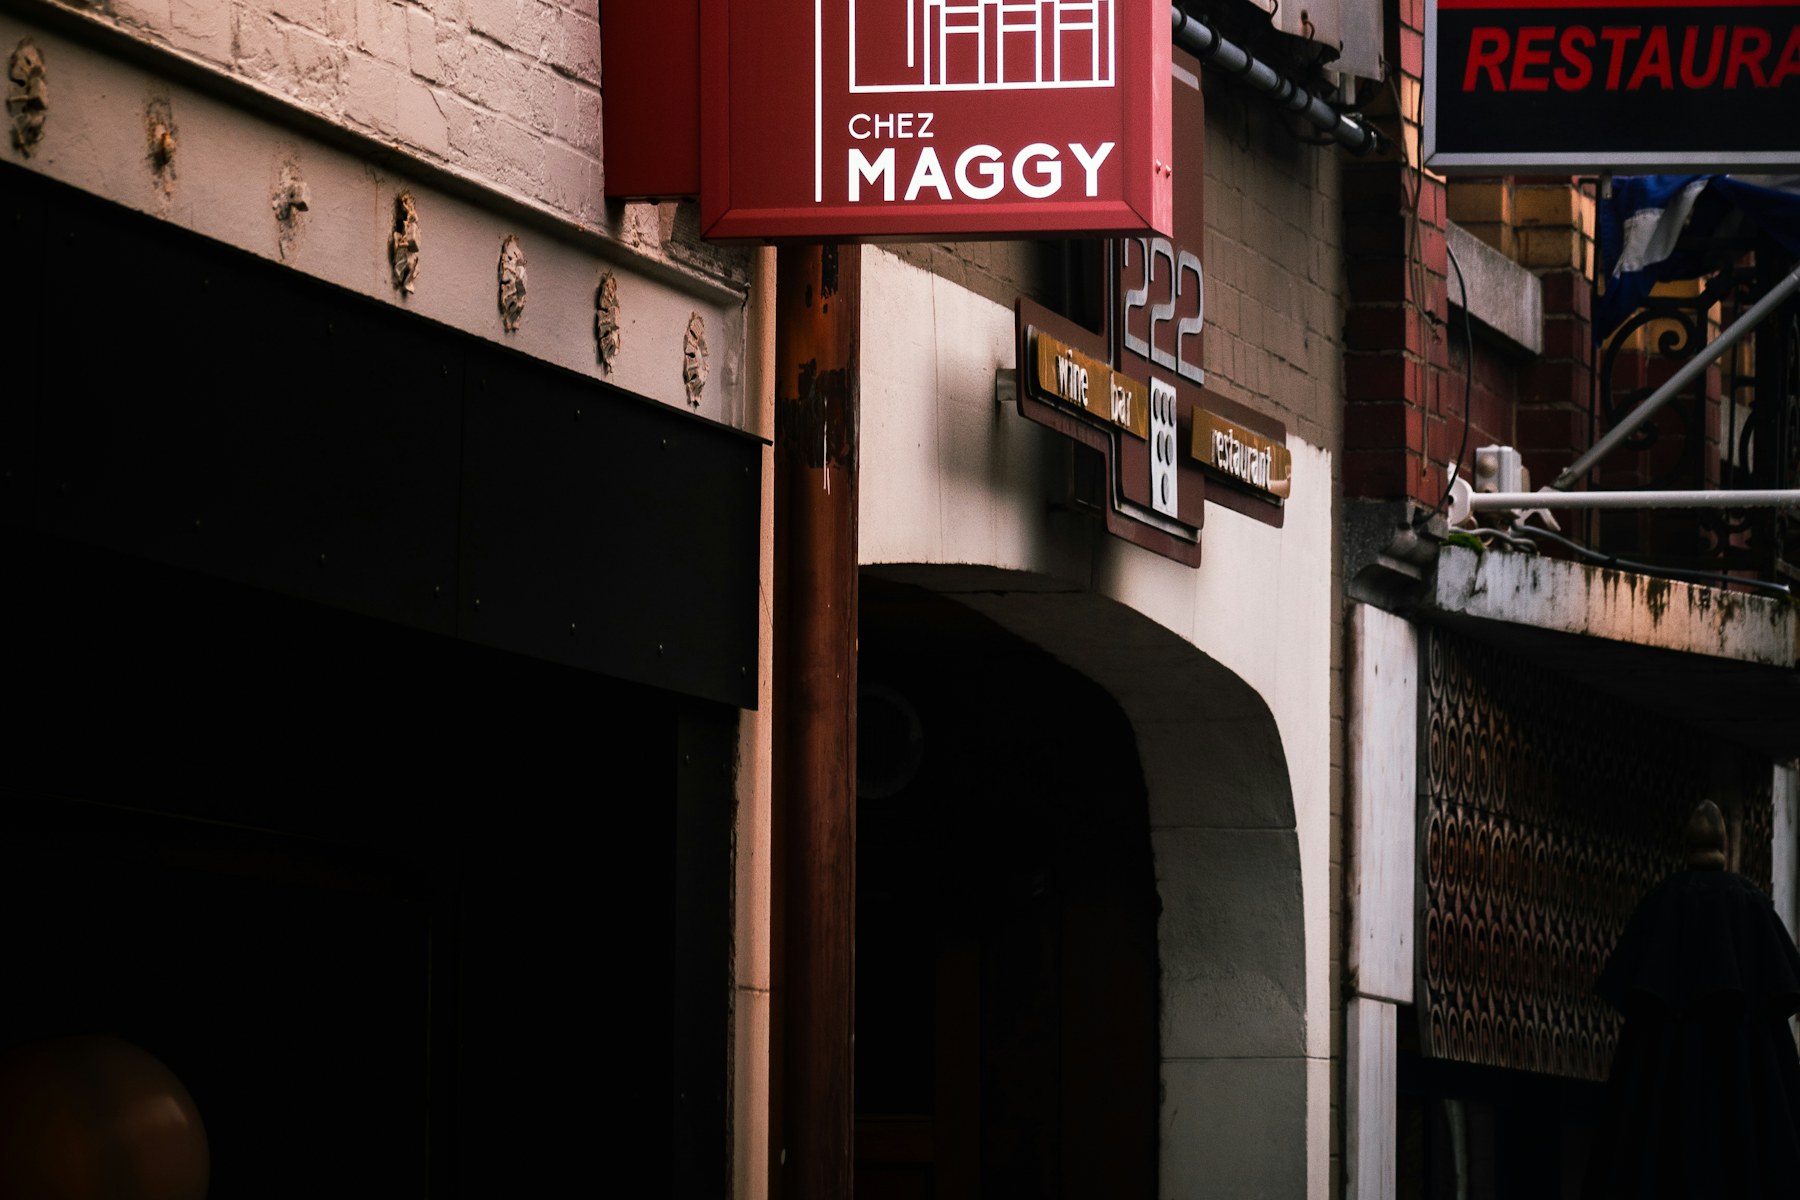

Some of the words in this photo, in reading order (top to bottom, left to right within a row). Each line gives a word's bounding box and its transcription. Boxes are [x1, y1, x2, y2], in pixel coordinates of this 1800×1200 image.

[1462, 24, 1800, 92] RESTAURA
[847, 111, 935, 140] CHEZ
[847, 141, 1116, 202] MAGGY
[1123, 237, 1204, 385] 222
[1056, 348, 1089, 408] wine
[1109, 370, 1133, 428] bar
[1210, 428, 1272, 492] restaurant
